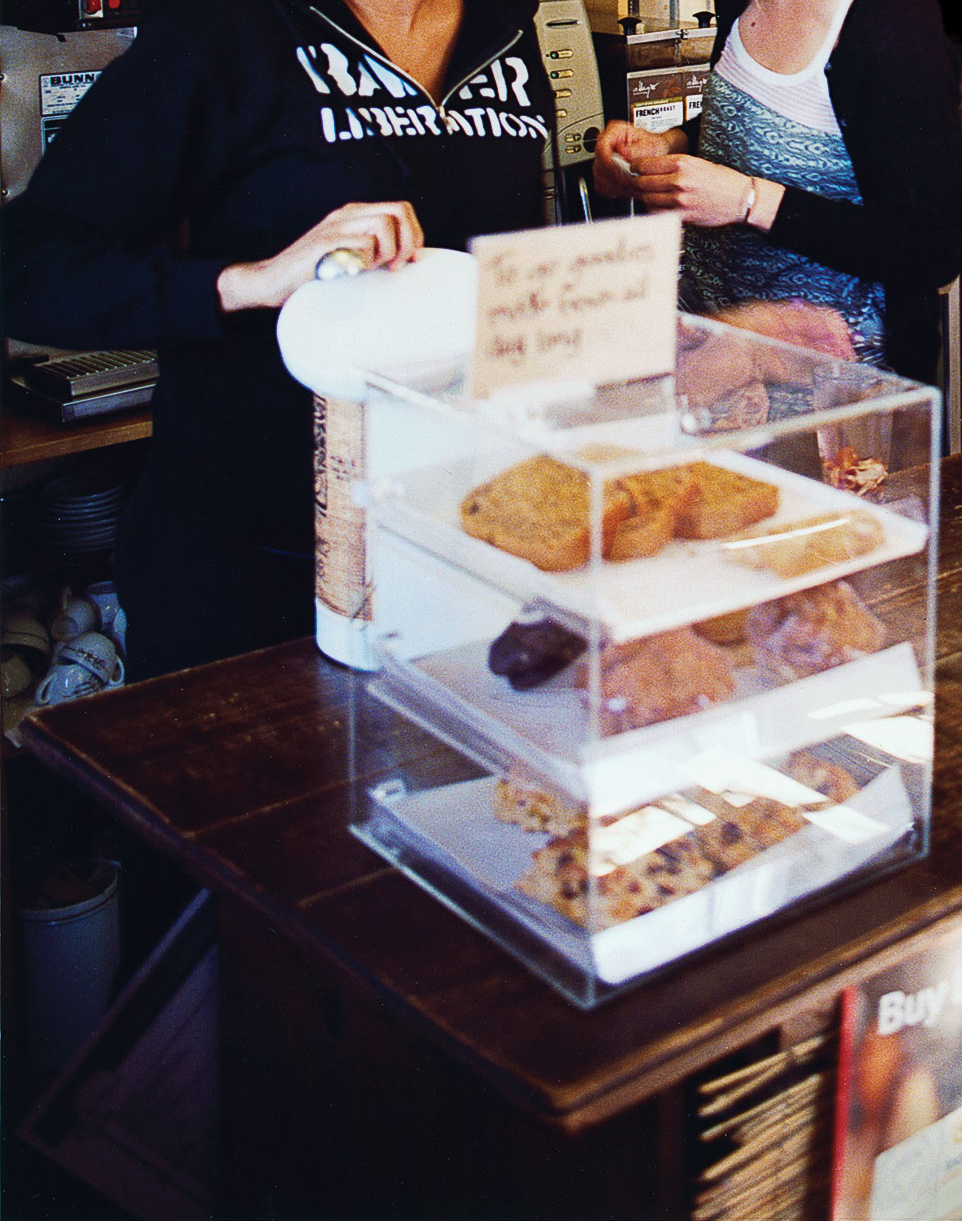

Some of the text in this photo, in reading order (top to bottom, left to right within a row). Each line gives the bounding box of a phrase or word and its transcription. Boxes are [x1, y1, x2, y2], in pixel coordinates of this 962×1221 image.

[50, 74, 96, 87] BUNN
[635, 106, 660, 118] FRENCH
[876, 983, 945, 1036] Buy
